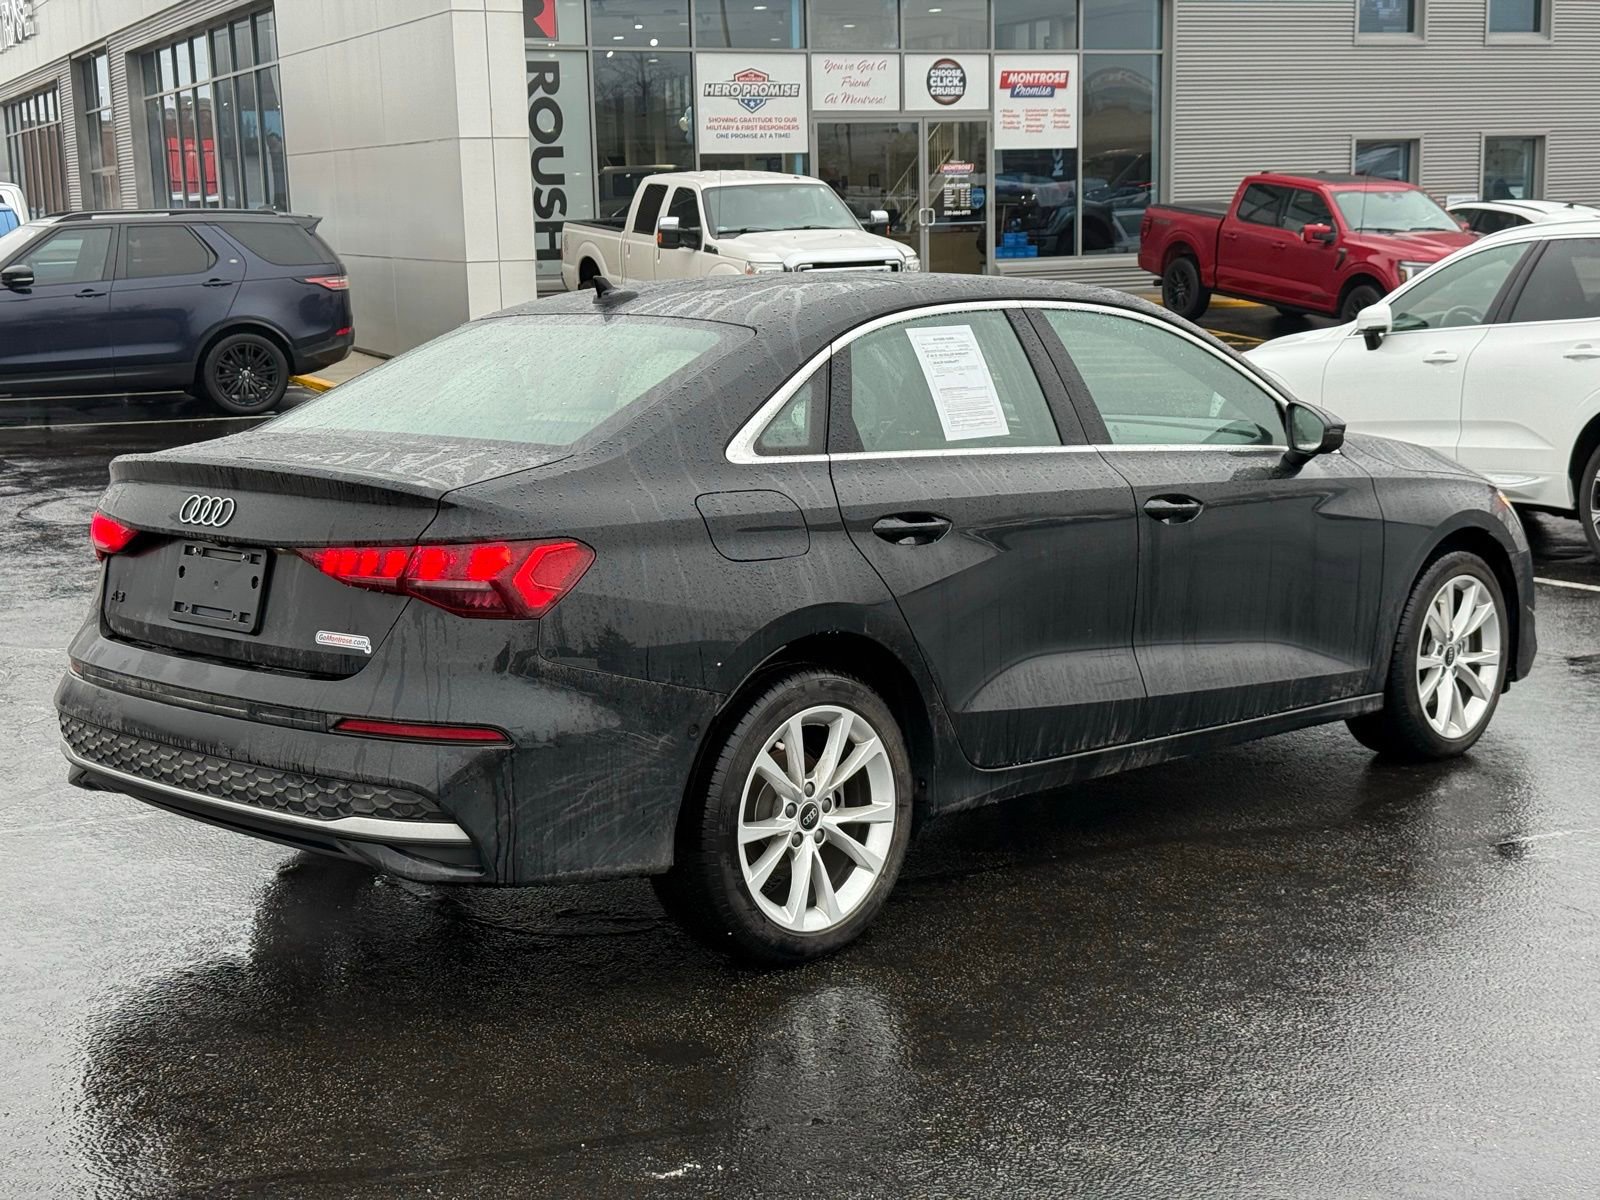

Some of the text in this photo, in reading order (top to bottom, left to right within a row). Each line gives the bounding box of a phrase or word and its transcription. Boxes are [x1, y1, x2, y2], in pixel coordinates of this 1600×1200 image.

[824, 58, 887, 74] You've Got A
[841, 75, 872, 88] Friend
[929, 77, 963, 87] CLICK.
[1007, 72, 1067, 84] MONTROSE
[704, 83, 800, 97] HERO PROMISE
[930, 87, 964, 96] CRUISE!
[1013, 83, 1053, 96] Promise
[824, 92, 887, 104] At Montrose!
[526, 61, 568, 260] ROUSH
[318, 633, 367, 646] GoMontrose.com
